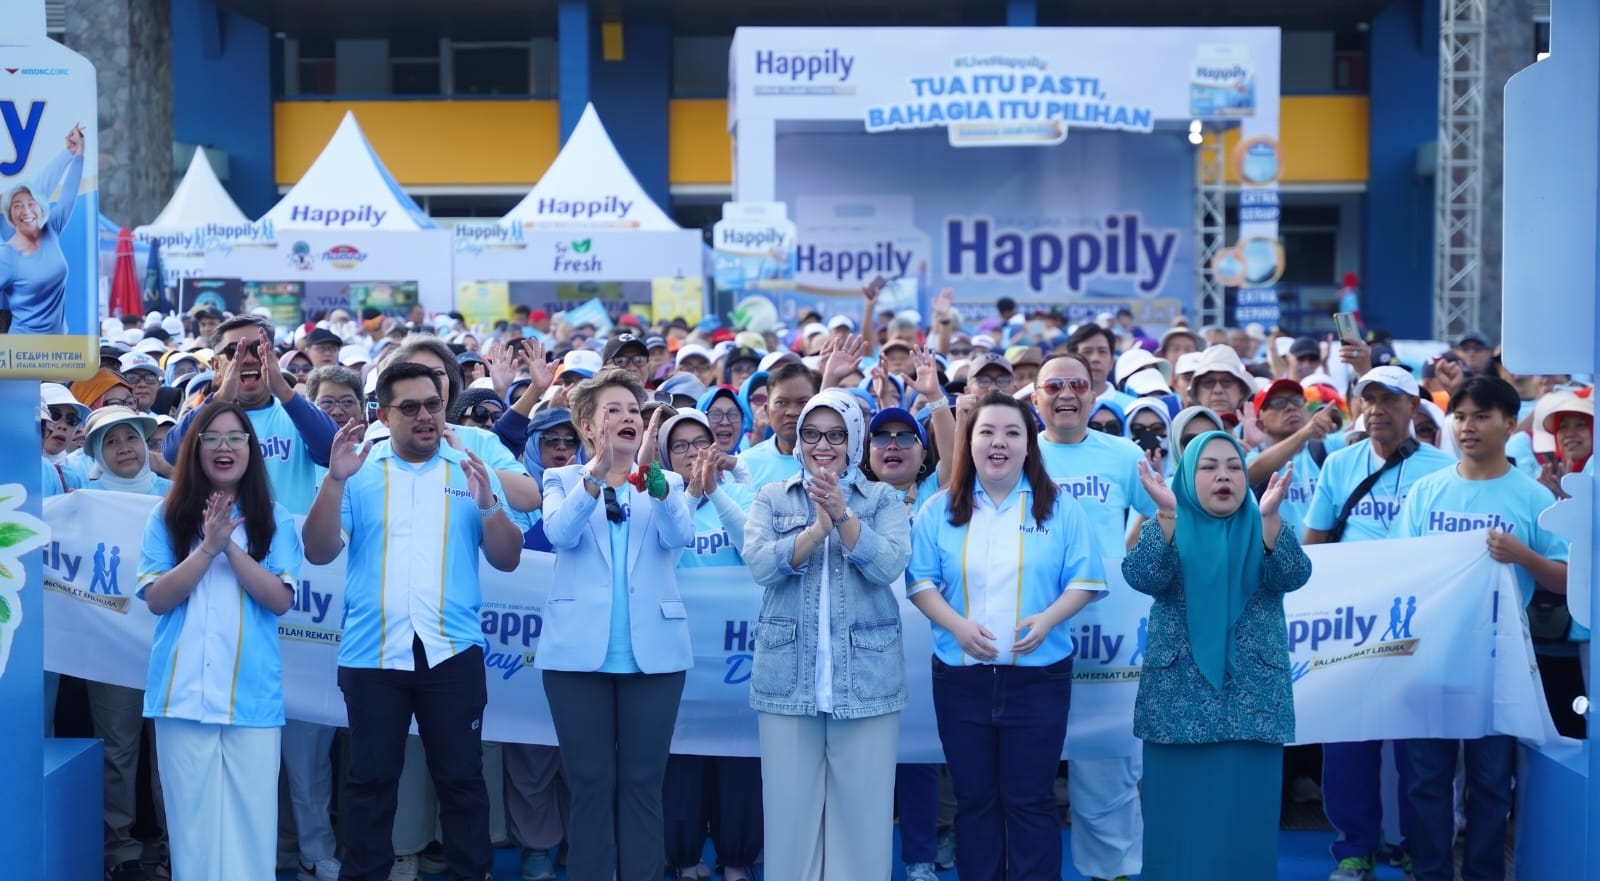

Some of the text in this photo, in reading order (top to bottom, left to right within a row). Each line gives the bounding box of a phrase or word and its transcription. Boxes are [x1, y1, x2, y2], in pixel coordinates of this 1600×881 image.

[756, 48, 855, 82] Happily
[911, 74, 1107, 100] TUA ITU PASTI,
[868, 100, 1151, 127] BAHAGIA ITU PILIHAN
[291, 204, 388, 227] Happily
[539, 195, 633, 219] Happily
[206, 223, 260, 240] Happily
[455, 223, 508, 241] Happily
[723, 229, 785, 246] Happily
[553, 256, 603, 273] Fresh
[796, 242, 912, 280] Happily
[948, 214, 1177, 293] Happily
[1287, 606, 1378, 653] ppily
[484, 637, 525, 681] ay
